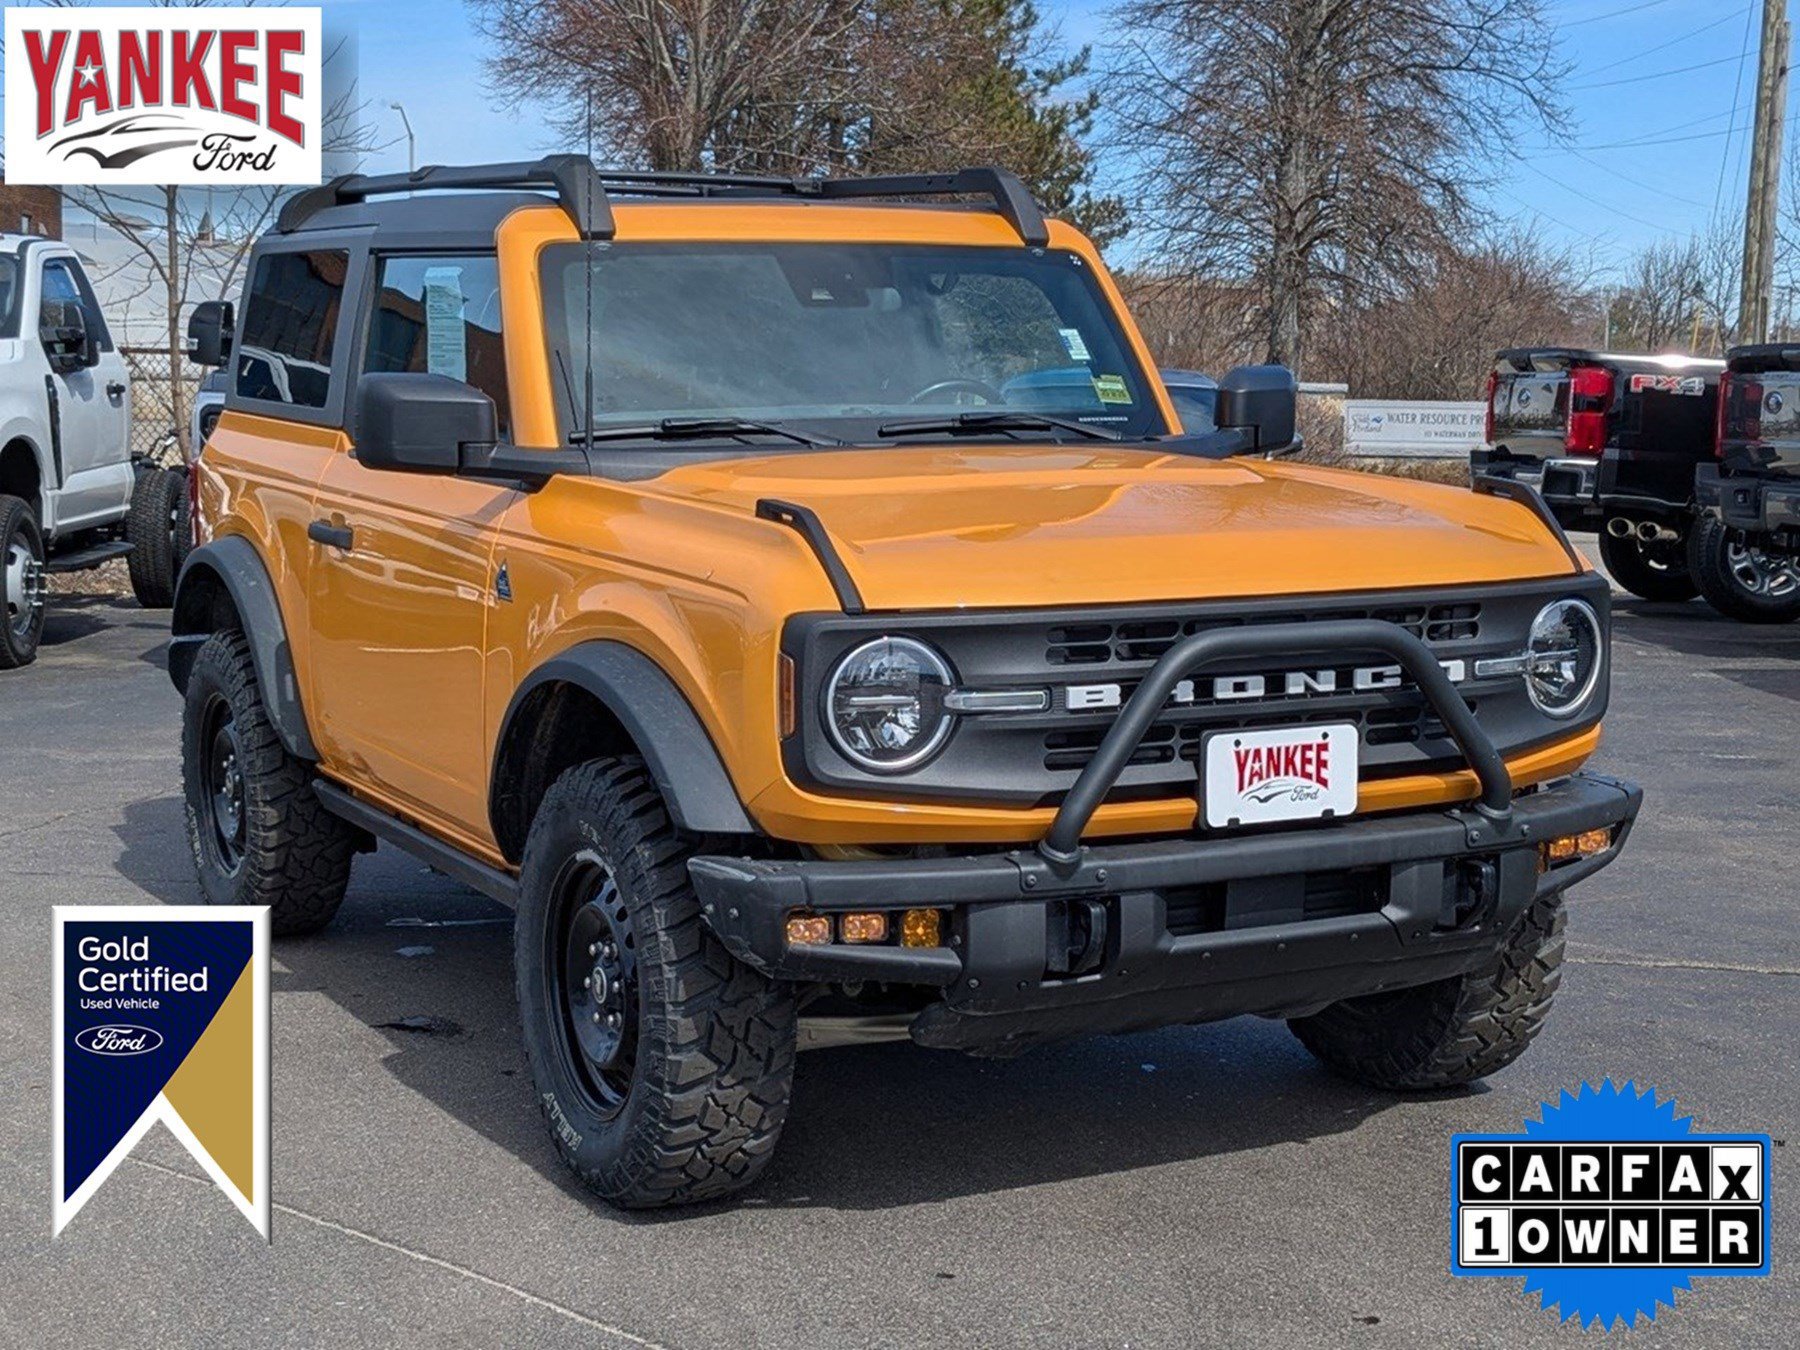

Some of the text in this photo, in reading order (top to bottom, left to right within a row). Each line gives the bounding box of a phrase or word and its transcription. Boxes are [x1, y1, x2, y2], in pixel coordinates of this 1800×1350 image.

[1630, 374, 1705, 396] FX4
[1387, 413, 1417, 425] WATER
[1420, 413, 1467, 426] RESOURCE
[1234, 742, 1329, 794] YANKEE
[1290, 785, 1320, 802] Ford
